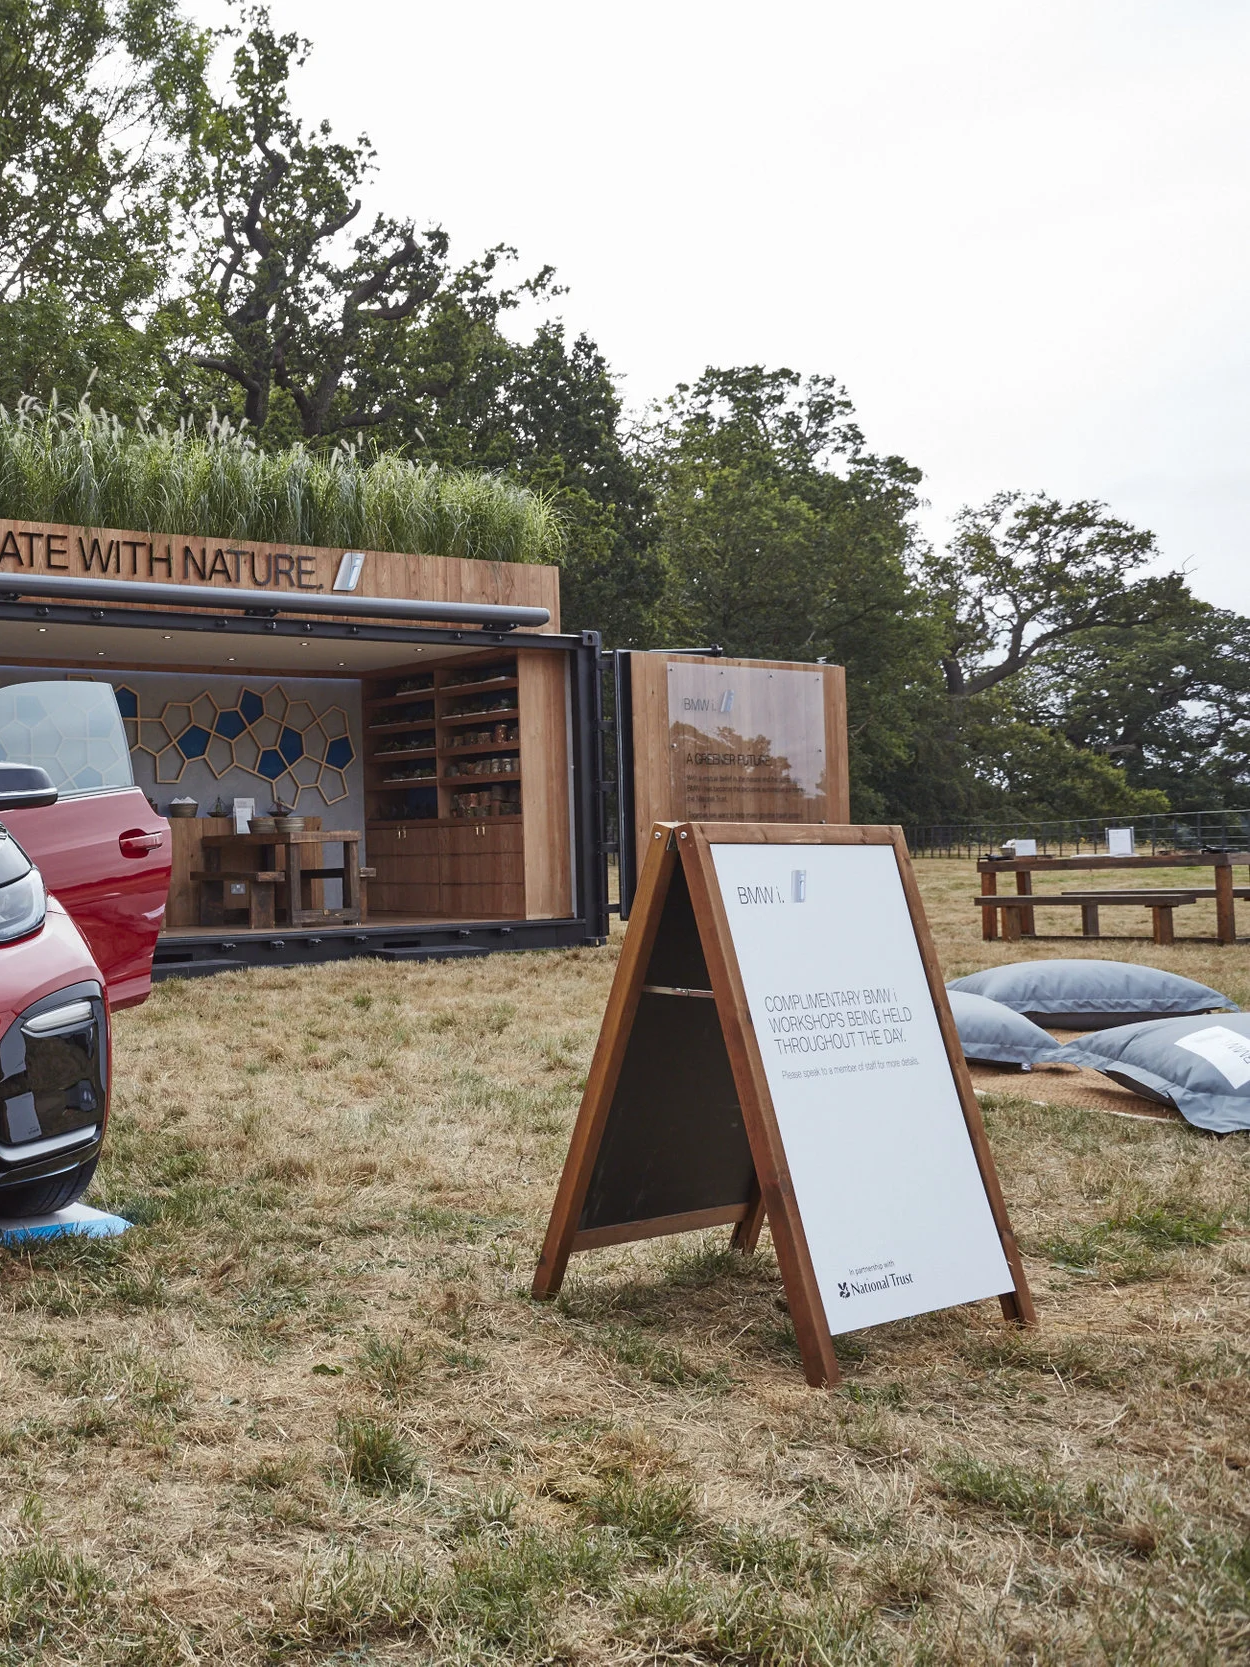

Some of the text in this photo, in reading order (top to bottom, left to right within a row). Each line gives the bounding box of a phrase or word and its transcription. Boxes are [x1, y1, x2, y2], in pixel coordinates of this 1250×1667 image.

[78, 536, 172, 578] WITH
[183, 545, 324, 590] NATURE.
[683, 697, 710, 711] BMW
[686, 753, 694, 765] A
[694, 753, 736, 766] GREENER
[737, 886, 774, 905] BMW
[764, 987, 898, 1013] COMPLIMENTARY BMW i
[768, 1006, 913, 1034] WORKSHOPS BEING HELD
[774, 1027, 907, 1055] THROUGHOUT THE DAY.
[781, 1069, 802, 1080] Please
[802, 1068, 821, 1079] speak
[821, 1067, 828, 1076] to
[829, 1067, 834, 1075] a
[833, 1064, 857, 1074] member
[857, 1062, 865, 1072] of
[864, 1060, 877, 1071] staff
[877, 1059, 885, 1070] for
[886, 1060, 901, 1069] more
[848, 1258, 895, 1276] In partnership with
[850, 1273, 914, 1296] National Trust
